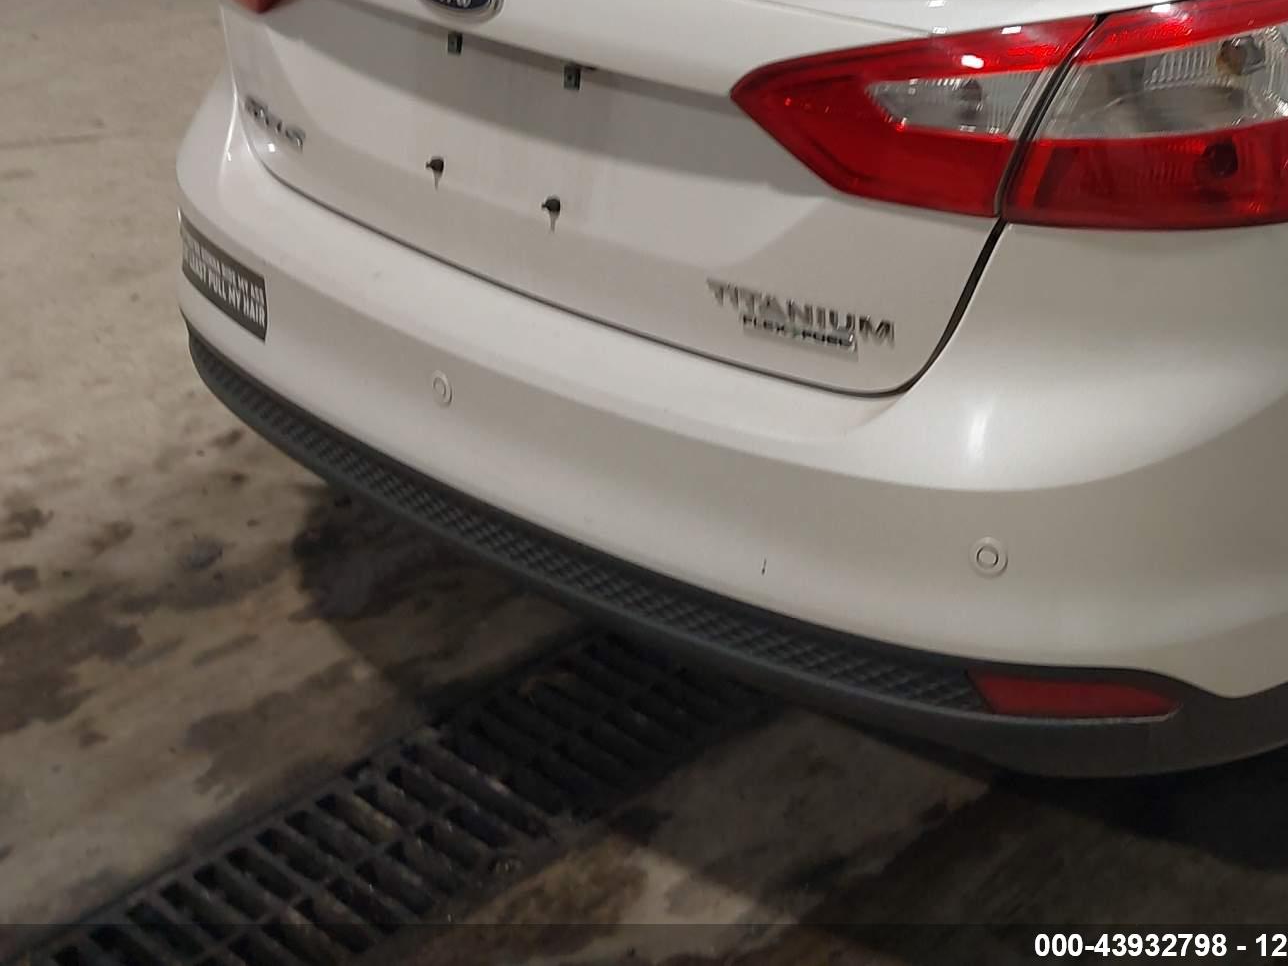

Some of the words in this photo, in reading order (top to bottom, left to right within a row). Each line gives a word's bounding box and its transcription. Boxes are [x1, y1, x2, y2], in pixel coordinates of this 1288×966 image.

[228, 284, 240, 311] MY
[243, 293, 265, 328] HAIR
[706, 278, 896, 343] TITANIUM
